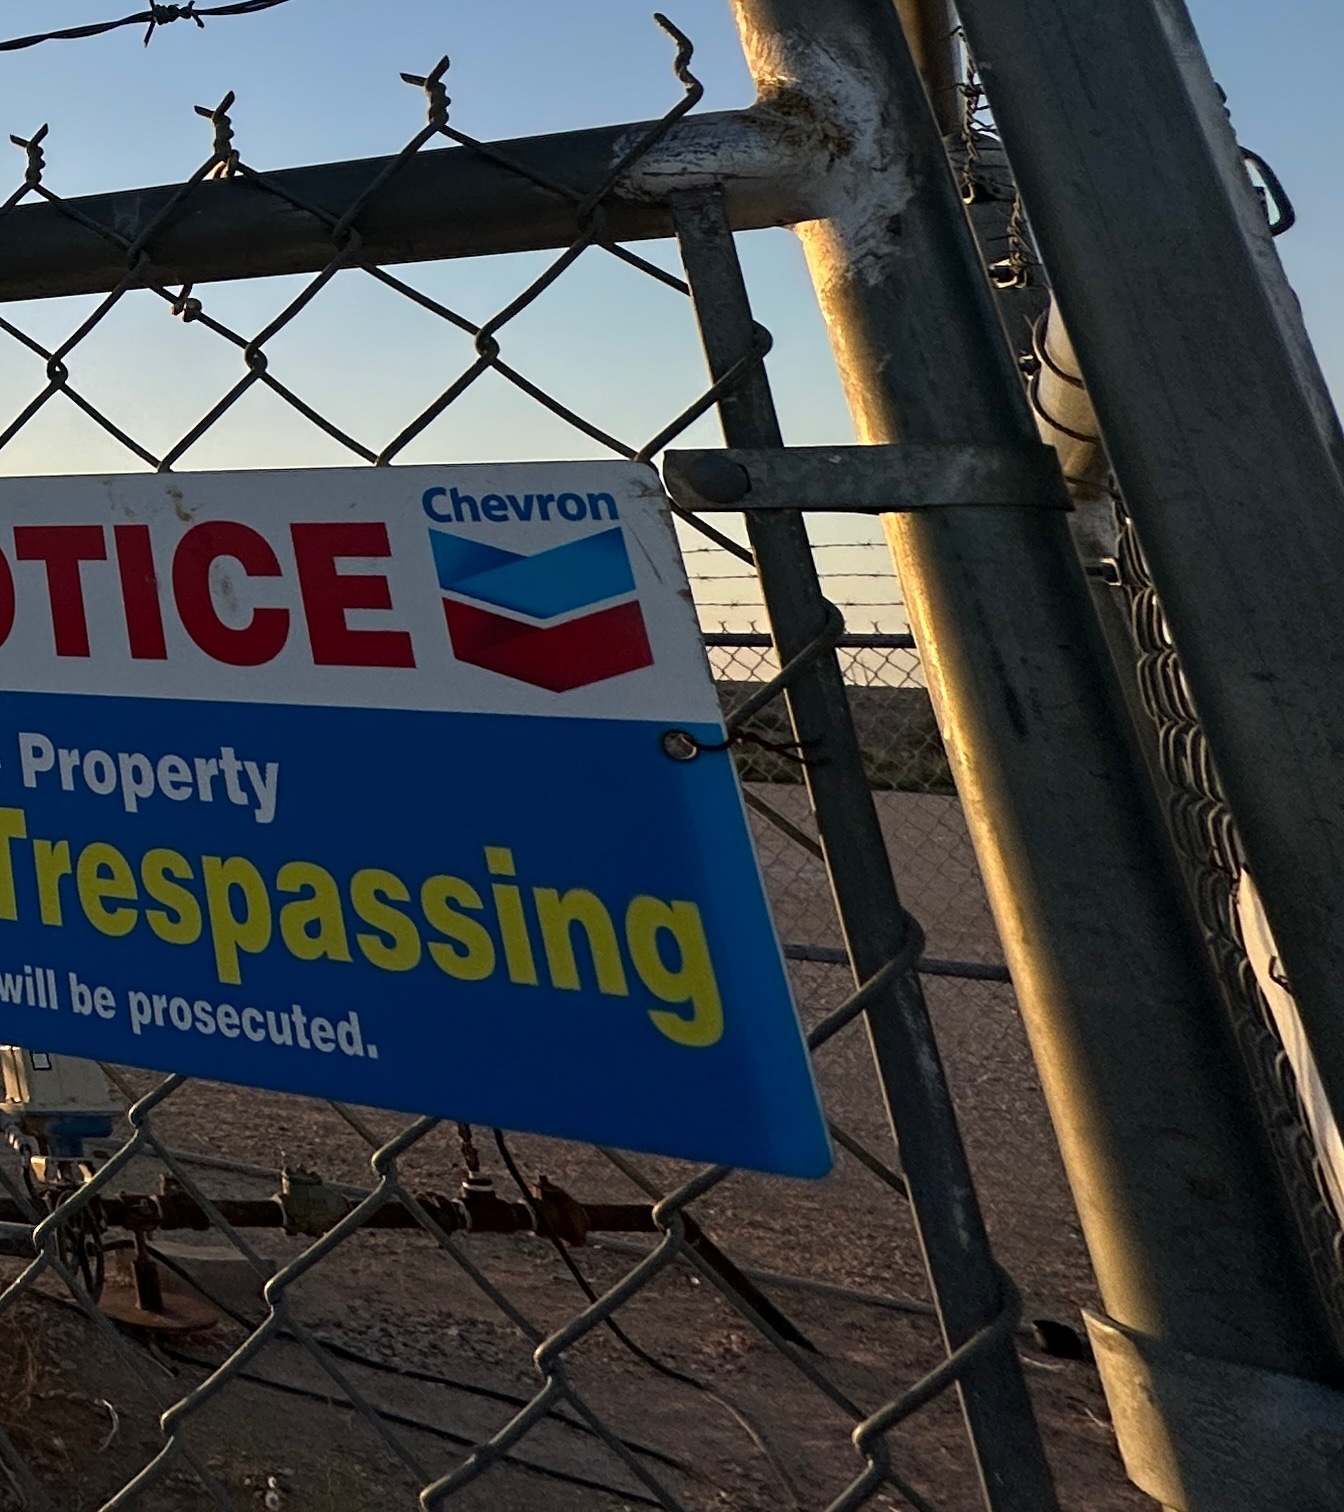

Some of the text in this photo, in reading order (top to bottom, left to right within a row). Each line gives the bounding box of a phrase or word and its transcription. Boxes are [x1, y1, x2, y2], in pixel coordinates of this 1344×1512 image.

[421, 486, 620, 524] Chevron
[18, 732, 279, 824] Property
[68, 972, 116, 1019] be
[128, 991, 379, 1060] prosecuted.
